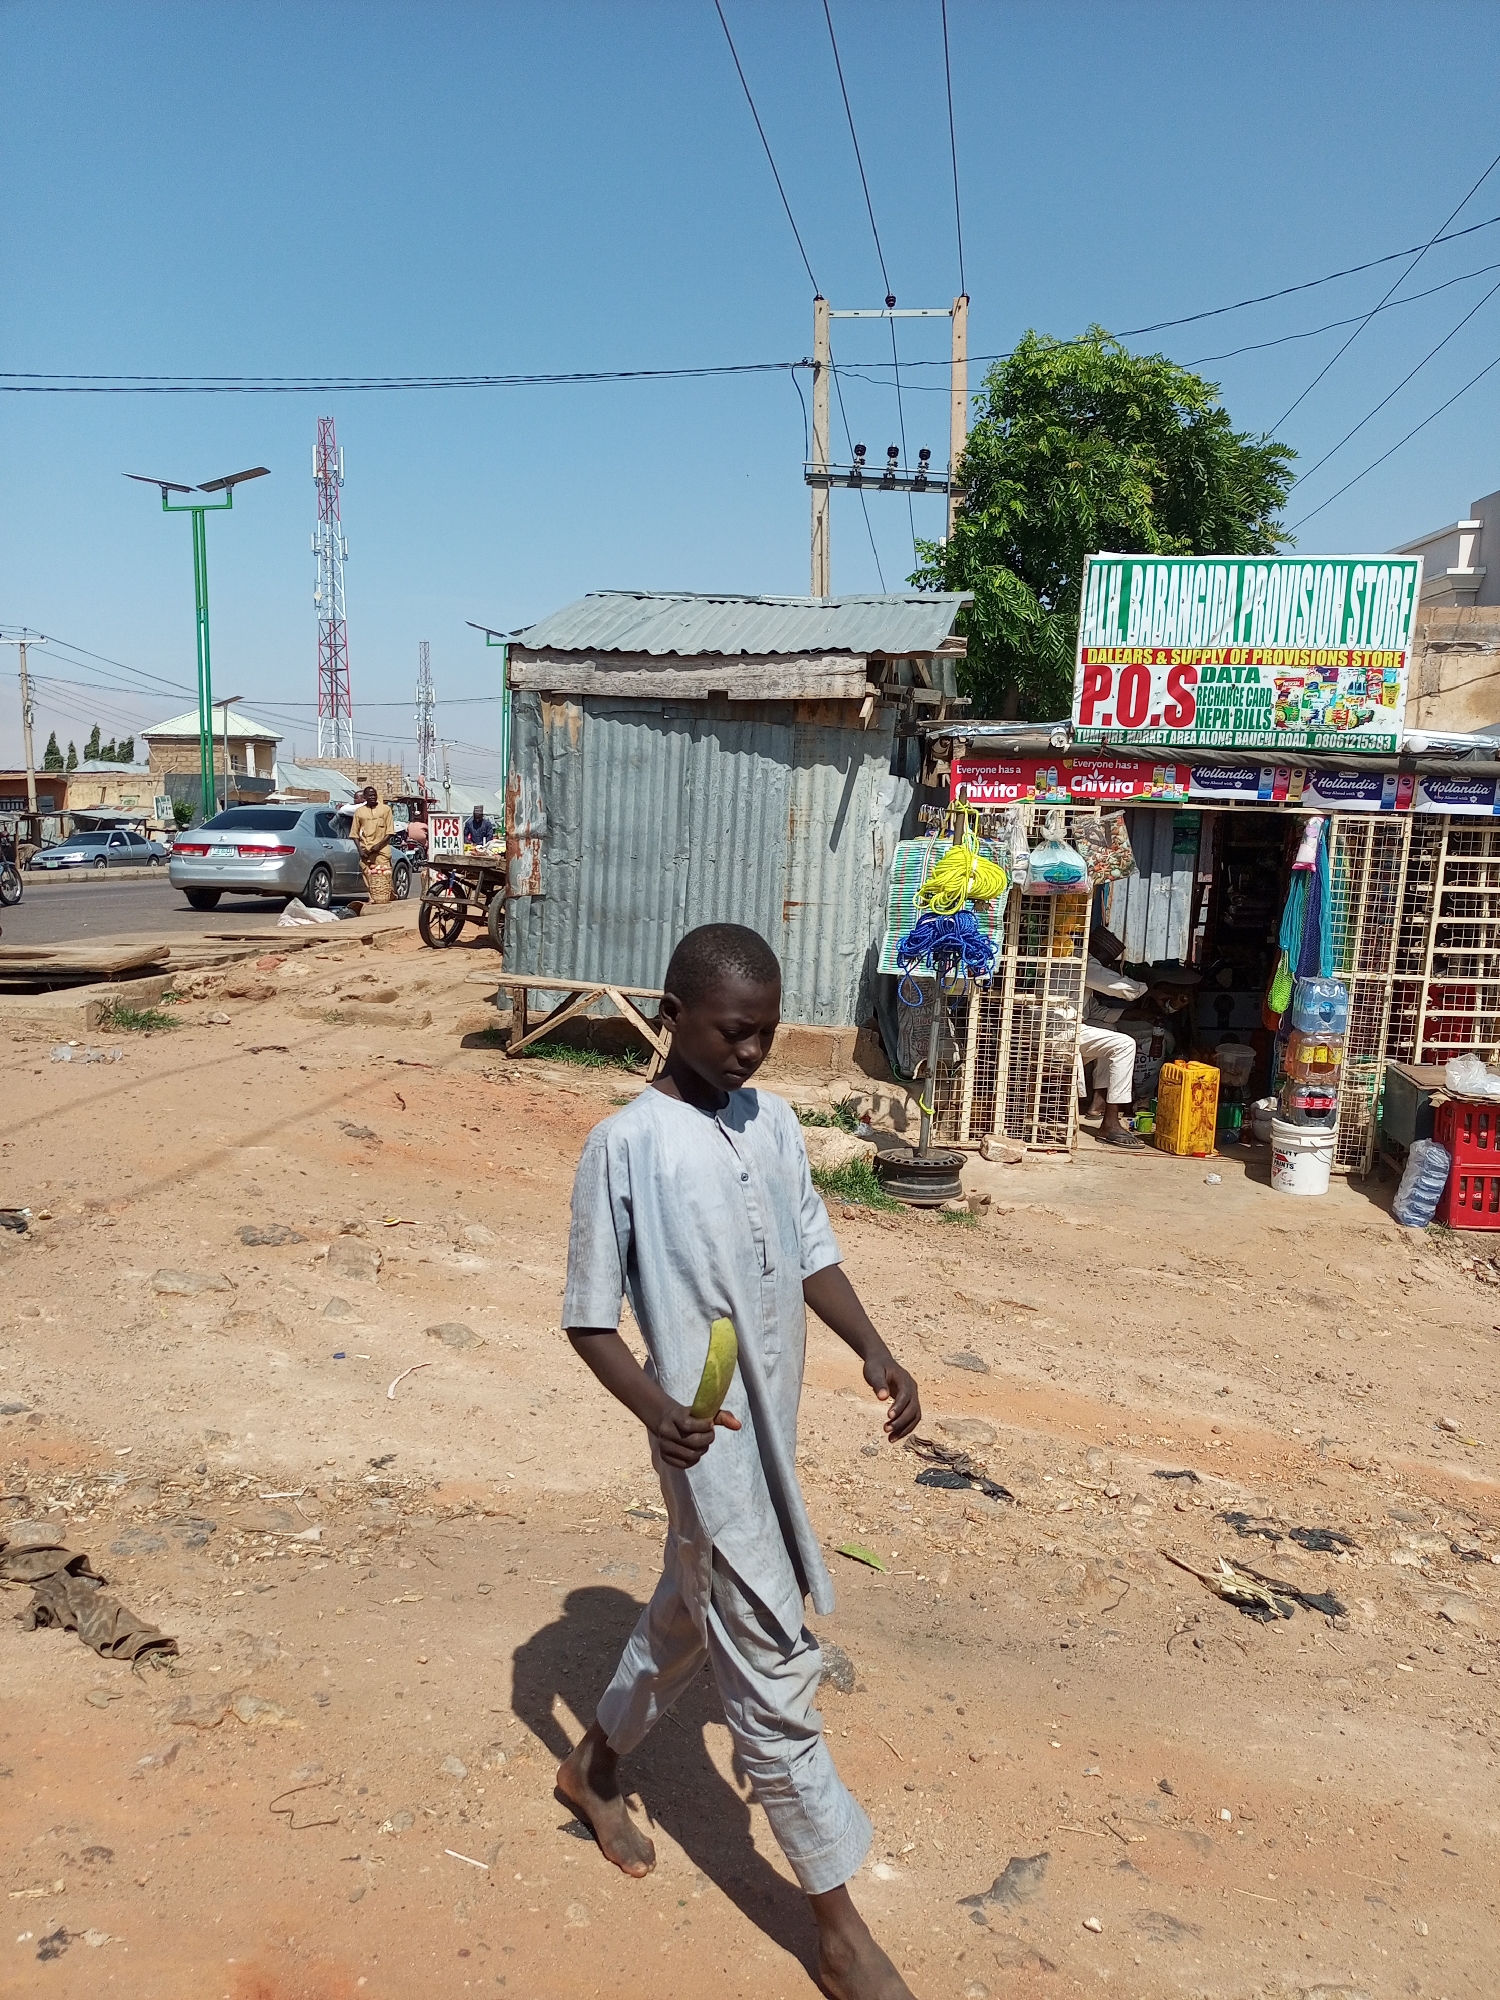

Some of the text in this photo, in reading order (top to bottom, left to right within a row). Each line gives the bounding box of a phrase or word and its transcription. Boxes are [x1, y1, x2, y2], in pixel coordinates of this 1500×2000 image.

[1126, 564, 1239, 648] BABANGIDA
[1237, 563, 1349, 649] PROVISION
[1346, 564, 1415, 650] STORE
[1087, 648, 1402, 668] DALEARS & SUPPLY OF PROVISIONS STORE
[1201, 666, 1261, 684] DATA
[1078, 664, 1198, 728] P.O.S
[1196, 685, 1273, 709] RECHARGE CARD
[1195, 707, 1273, 731] NEPA BILLS
[1126, 730, 1169, 744] MARKET
[1169, 730, 1197, 745] AREA
[1198, 730, 1233, 746] ALONG
[1234, 731, 1276, 747] BAUCHI
[956, 764, 997, 775] Everyone
[998, 764, 1015, 774] has
[1072, 758, 1139, 770] Everyone has a
[1196, 766, 1256, 780] Hollandia
[955, 781, 1018, 798] Chivita
[1071, 775, 1134, 794] Chivita
[1317, 777, 1378, 790] Hollandia
[1429, 781, 1490, 795] Hollandia
[434, 818, 460, 837] POS
[434, 836, 460, 849] NEPA
[1273, 1159, 1295, 1170] PAINTS
